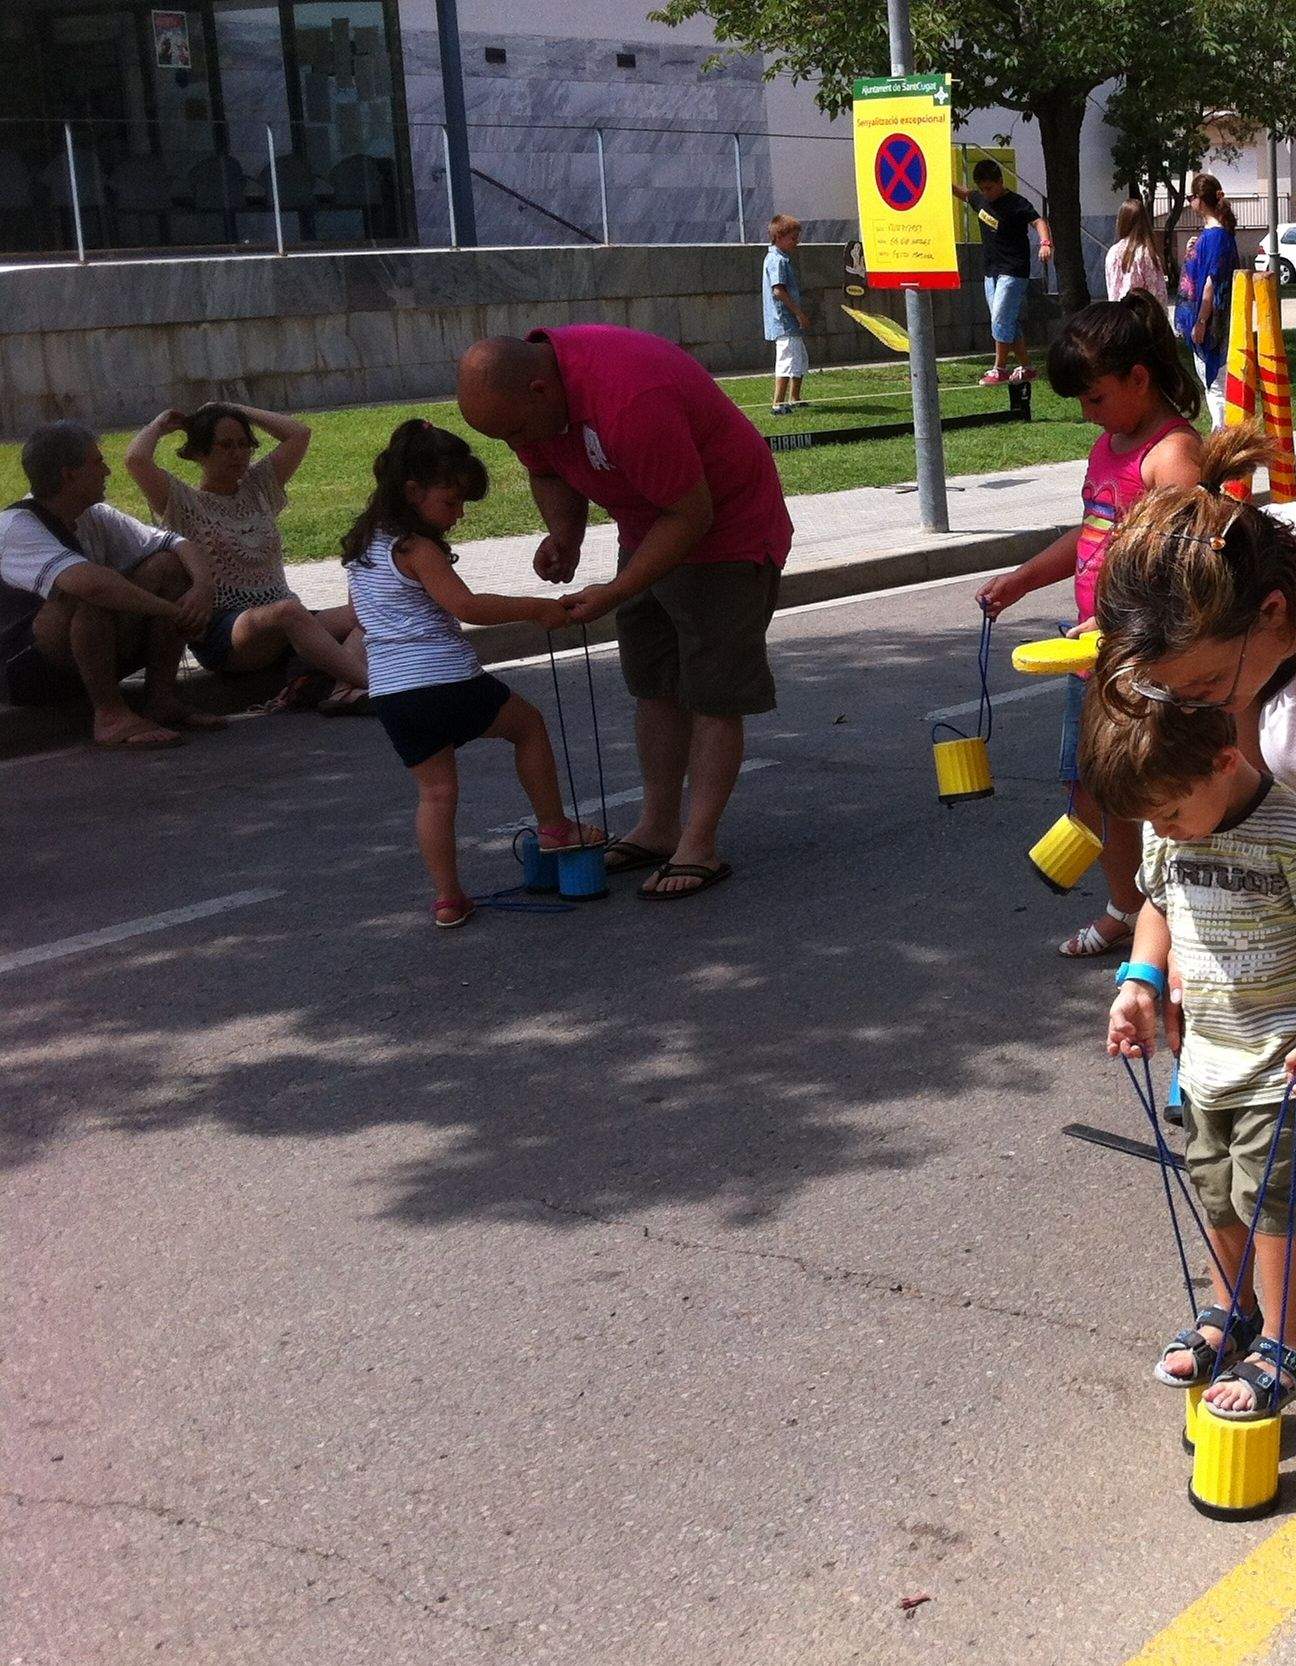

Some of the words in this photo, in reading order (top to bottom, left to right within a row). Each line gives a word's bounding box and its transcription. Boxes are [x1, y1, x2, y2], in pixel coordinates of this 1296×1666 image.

[861, 84, 892, 95] Ajuntament
[892, 83, 901, 91] de
[900, 114, 945, 125] excepcional
